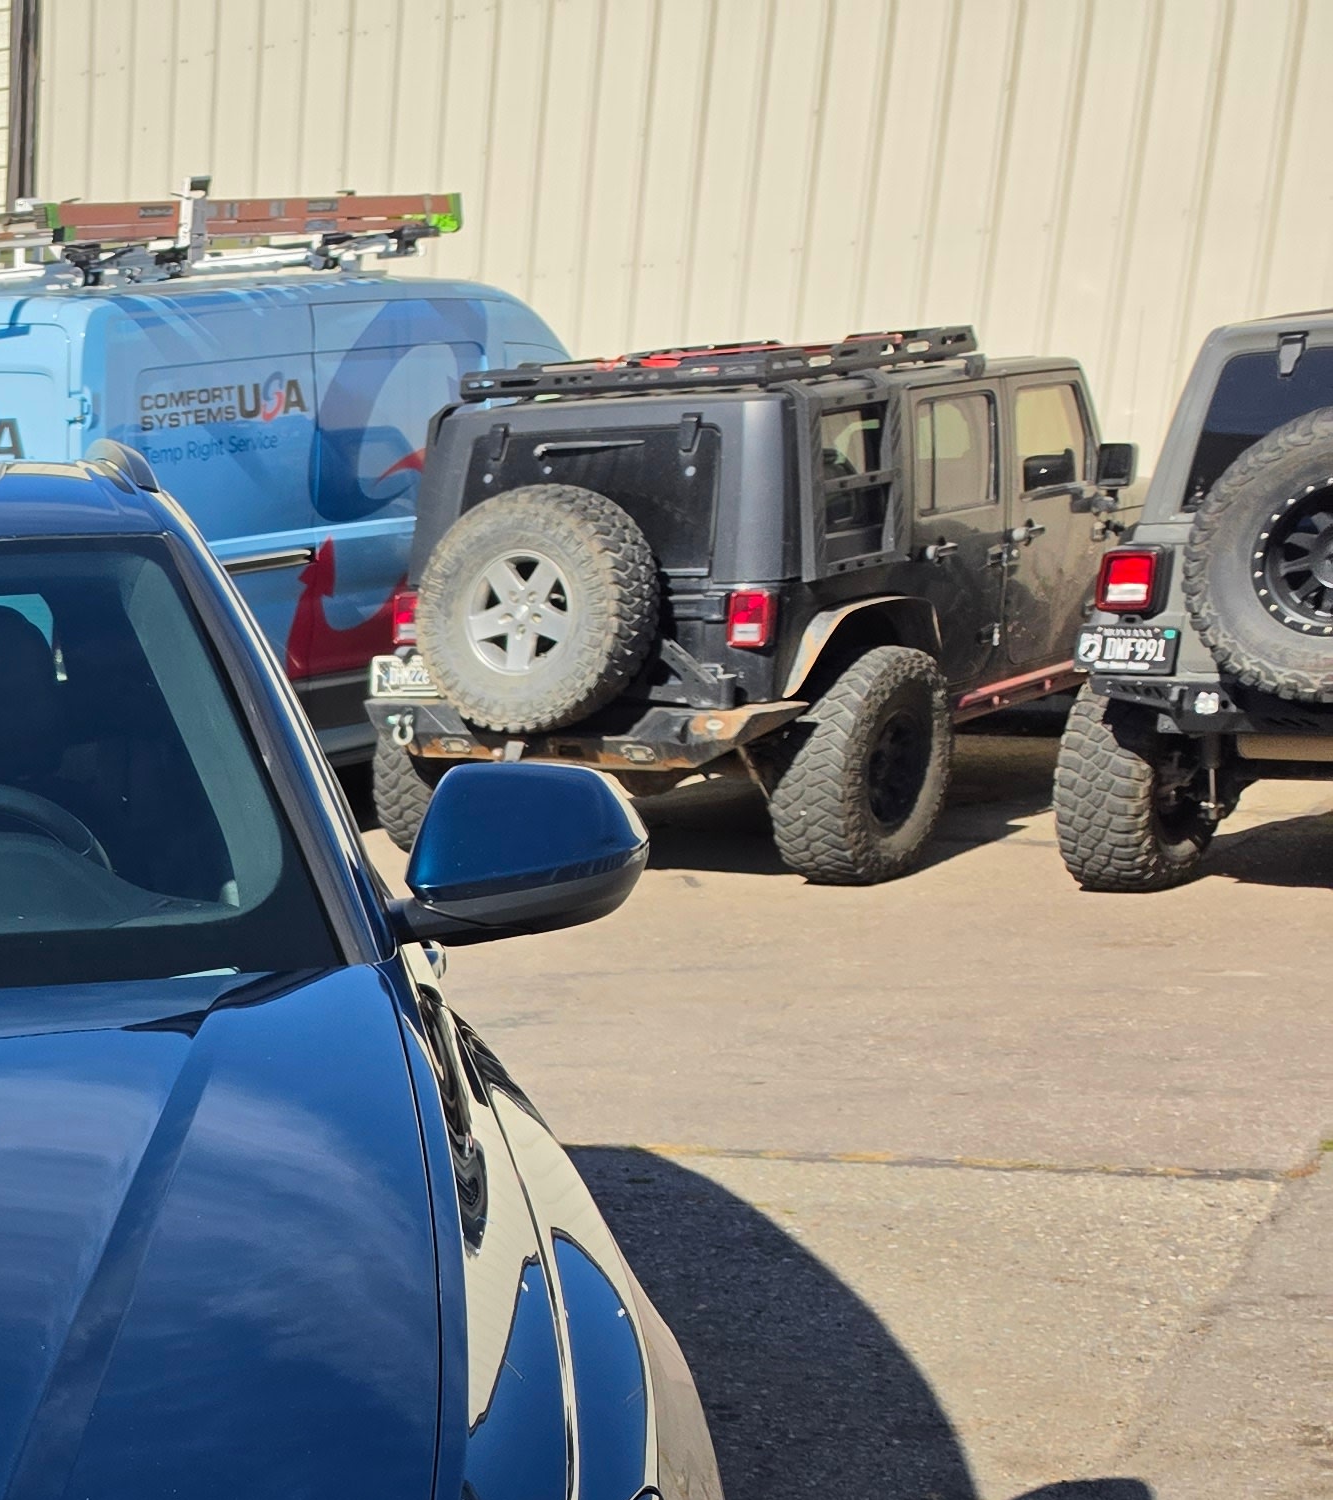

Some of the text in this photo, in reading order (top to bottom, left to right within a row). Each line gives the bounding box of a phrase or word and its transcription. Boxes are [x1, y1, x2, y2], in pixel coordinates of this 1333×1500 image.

[140, 386, 235, 411] COMFORT
[238, 371, 309, 421] USA
[140, 405, 237, 431] SYSTEMS
[141, 432, 279, 465] Temp Right Service
